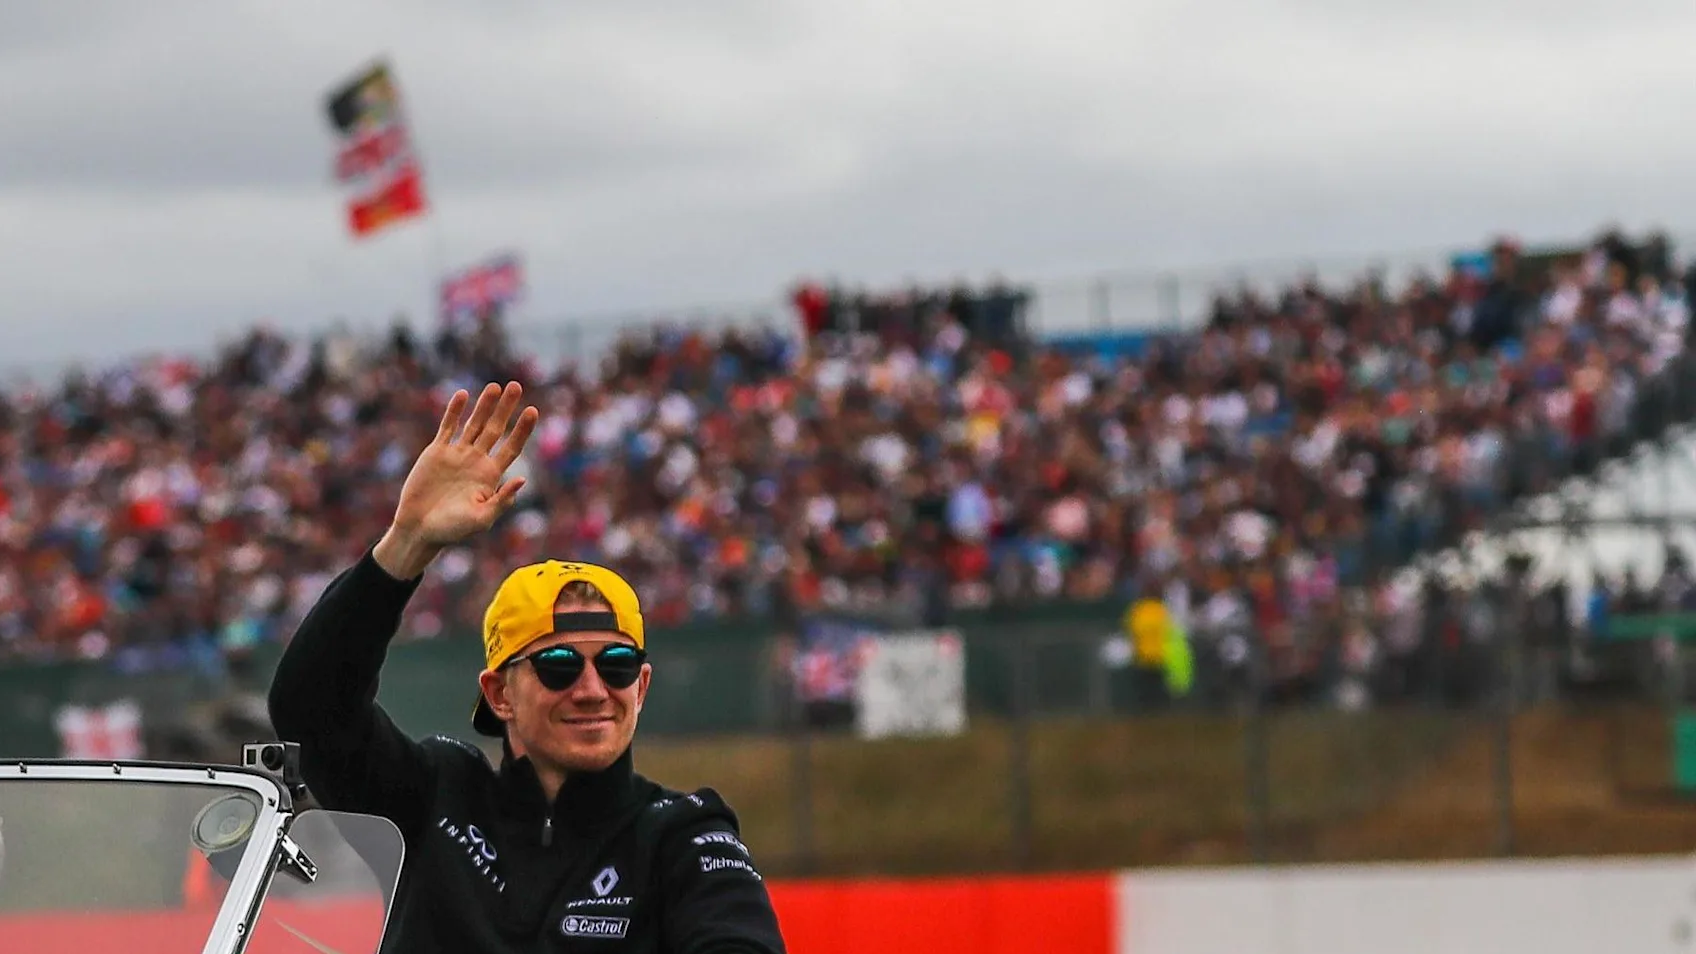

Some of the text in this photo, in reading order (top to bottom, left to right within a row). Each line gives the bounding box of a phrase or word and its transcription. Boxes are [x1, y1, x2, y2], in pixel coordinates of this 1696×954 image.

[438, 817, 506, 893] INFINITI
[567, 896, 633, 909] RENAULT
[579, 919, 624, 934] Castrol
